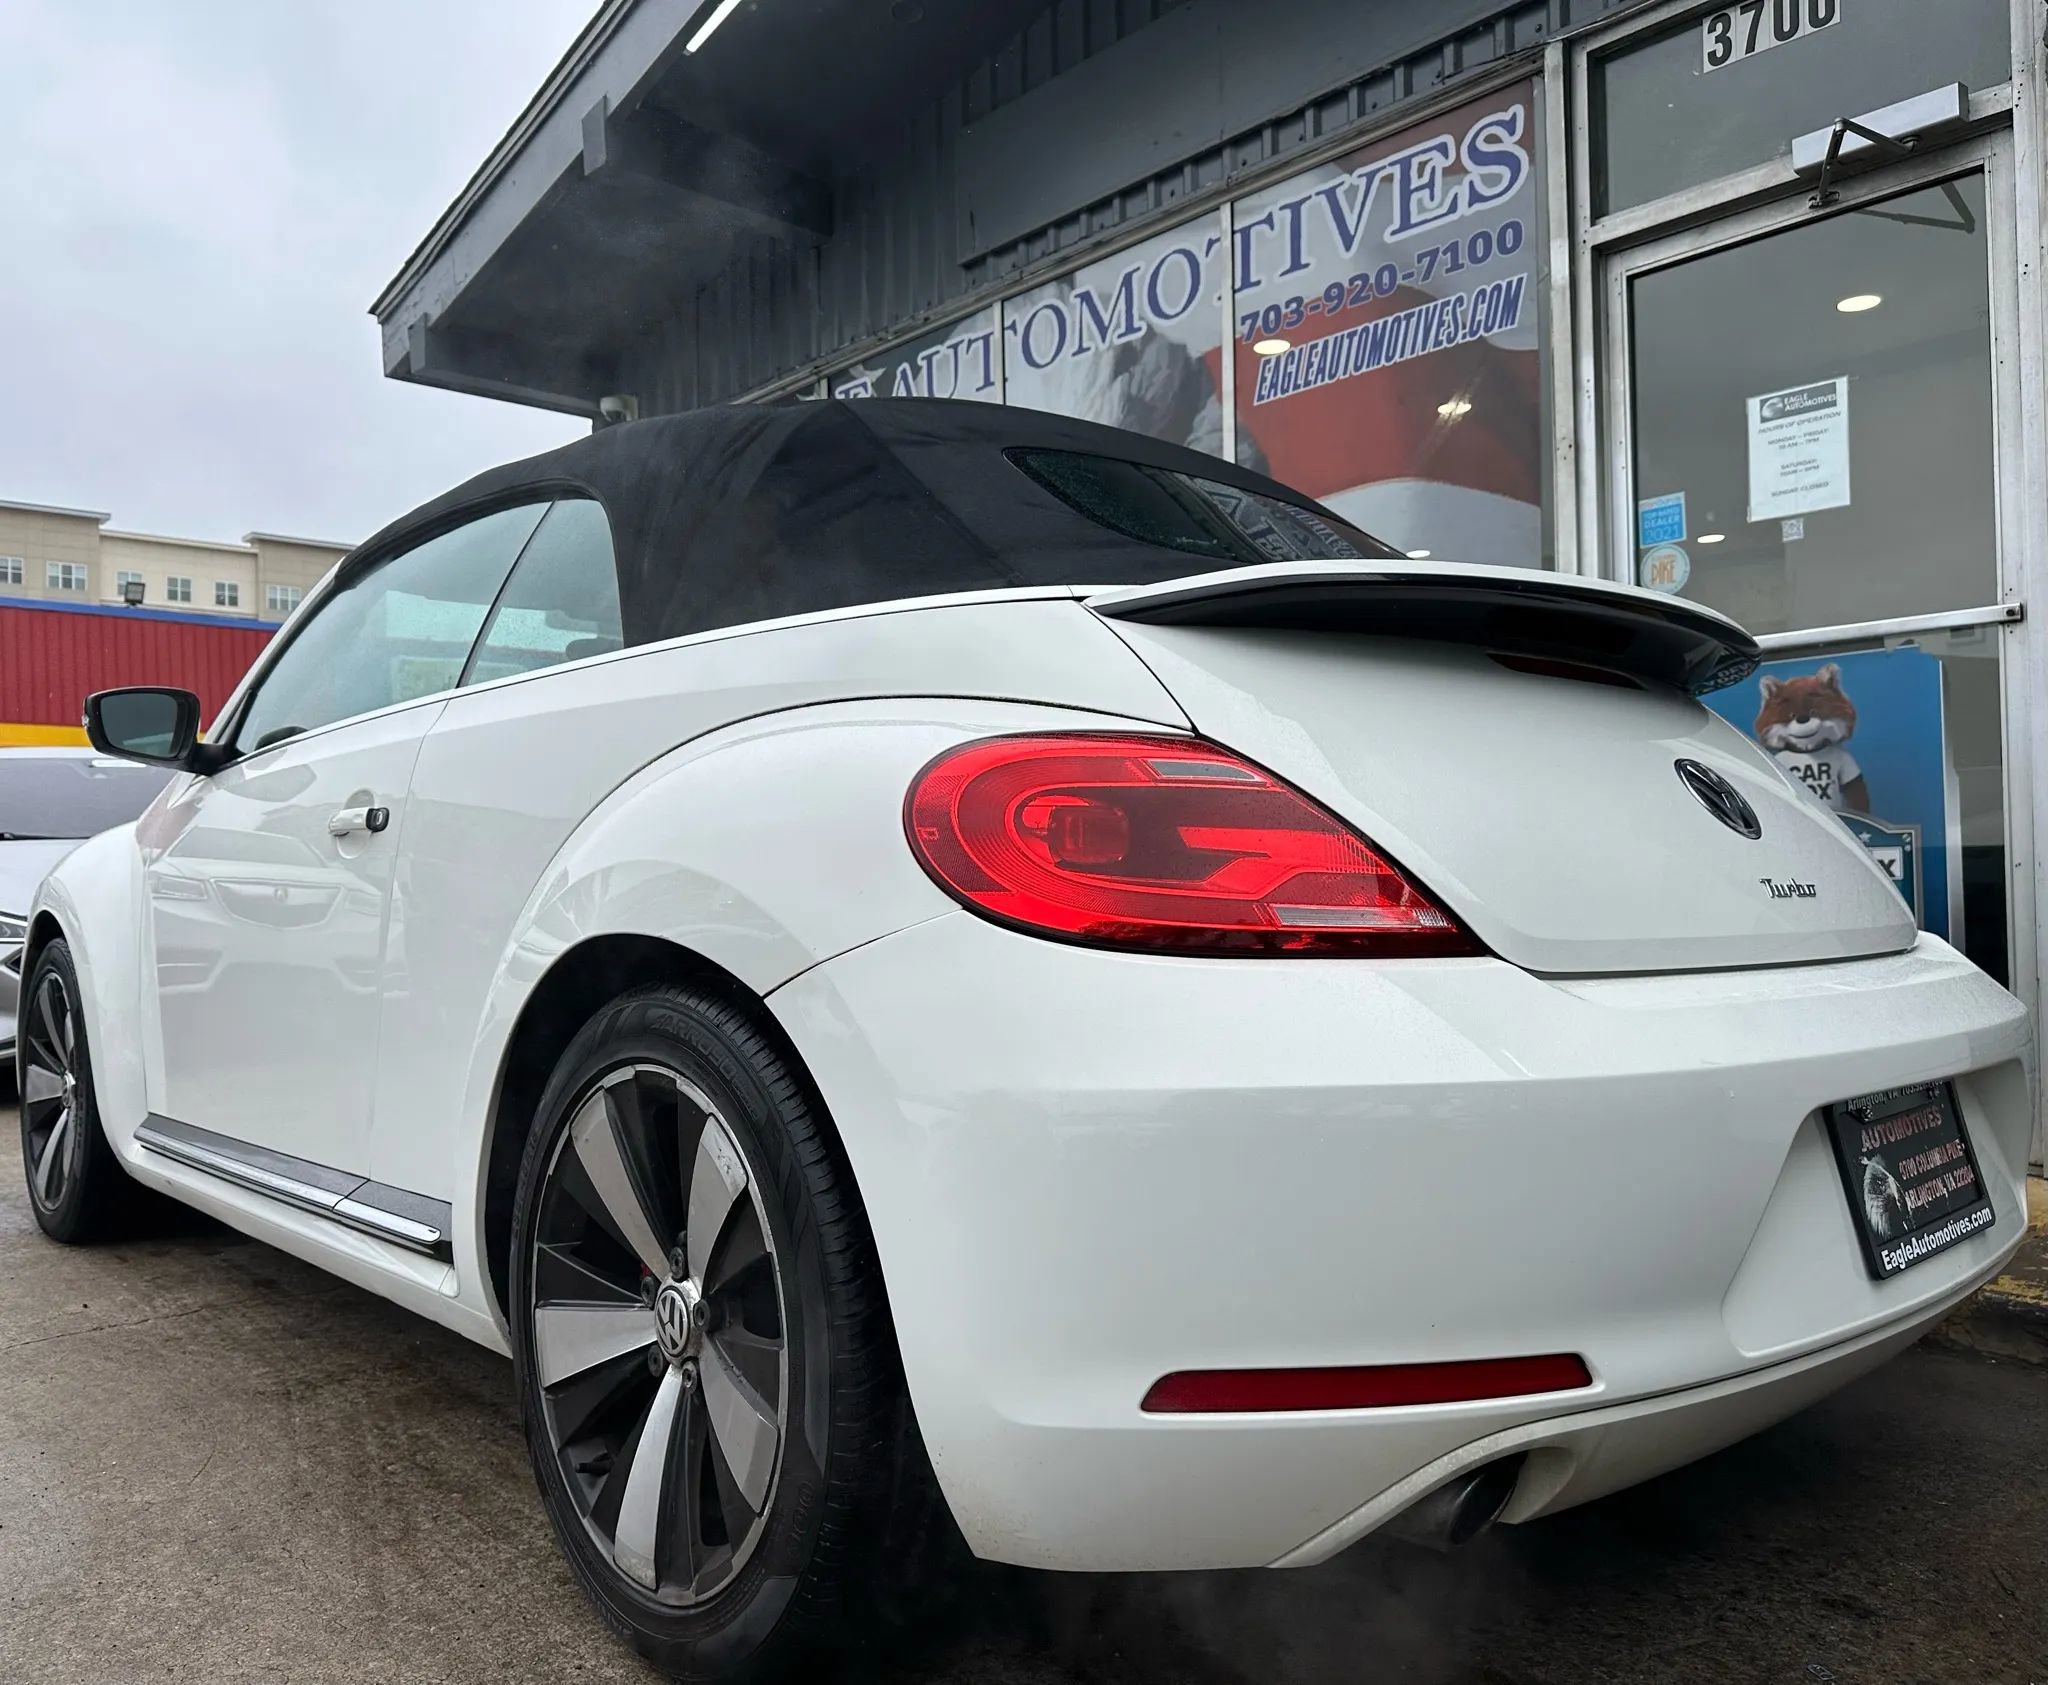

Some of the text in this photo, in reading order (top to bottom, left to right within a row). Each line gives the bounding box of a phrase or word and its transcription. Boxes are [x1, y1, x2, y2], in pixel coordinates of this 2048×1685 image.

[1706, 0, 1836, 67] 3700
[893, 106, 1526, 400] AUTOMOTIVES
[1240, 219, 1524, 343] 703-920-7100
[1254, 273, 1527, 405] EAGLEAUTOMOTIVES.COM
[1783, 393, 1808, 405] EAGLE
[1800, 480, 1830, 492] CLOSED
[1645, 525, 1680, 544] 2021
[1759, 878, 1816, 899] Turbo
[1861, 1105, 1942, 1152] AUTOMOTIVES
[1881, 1206, 1992, 1272] EagleAutomotives.com
